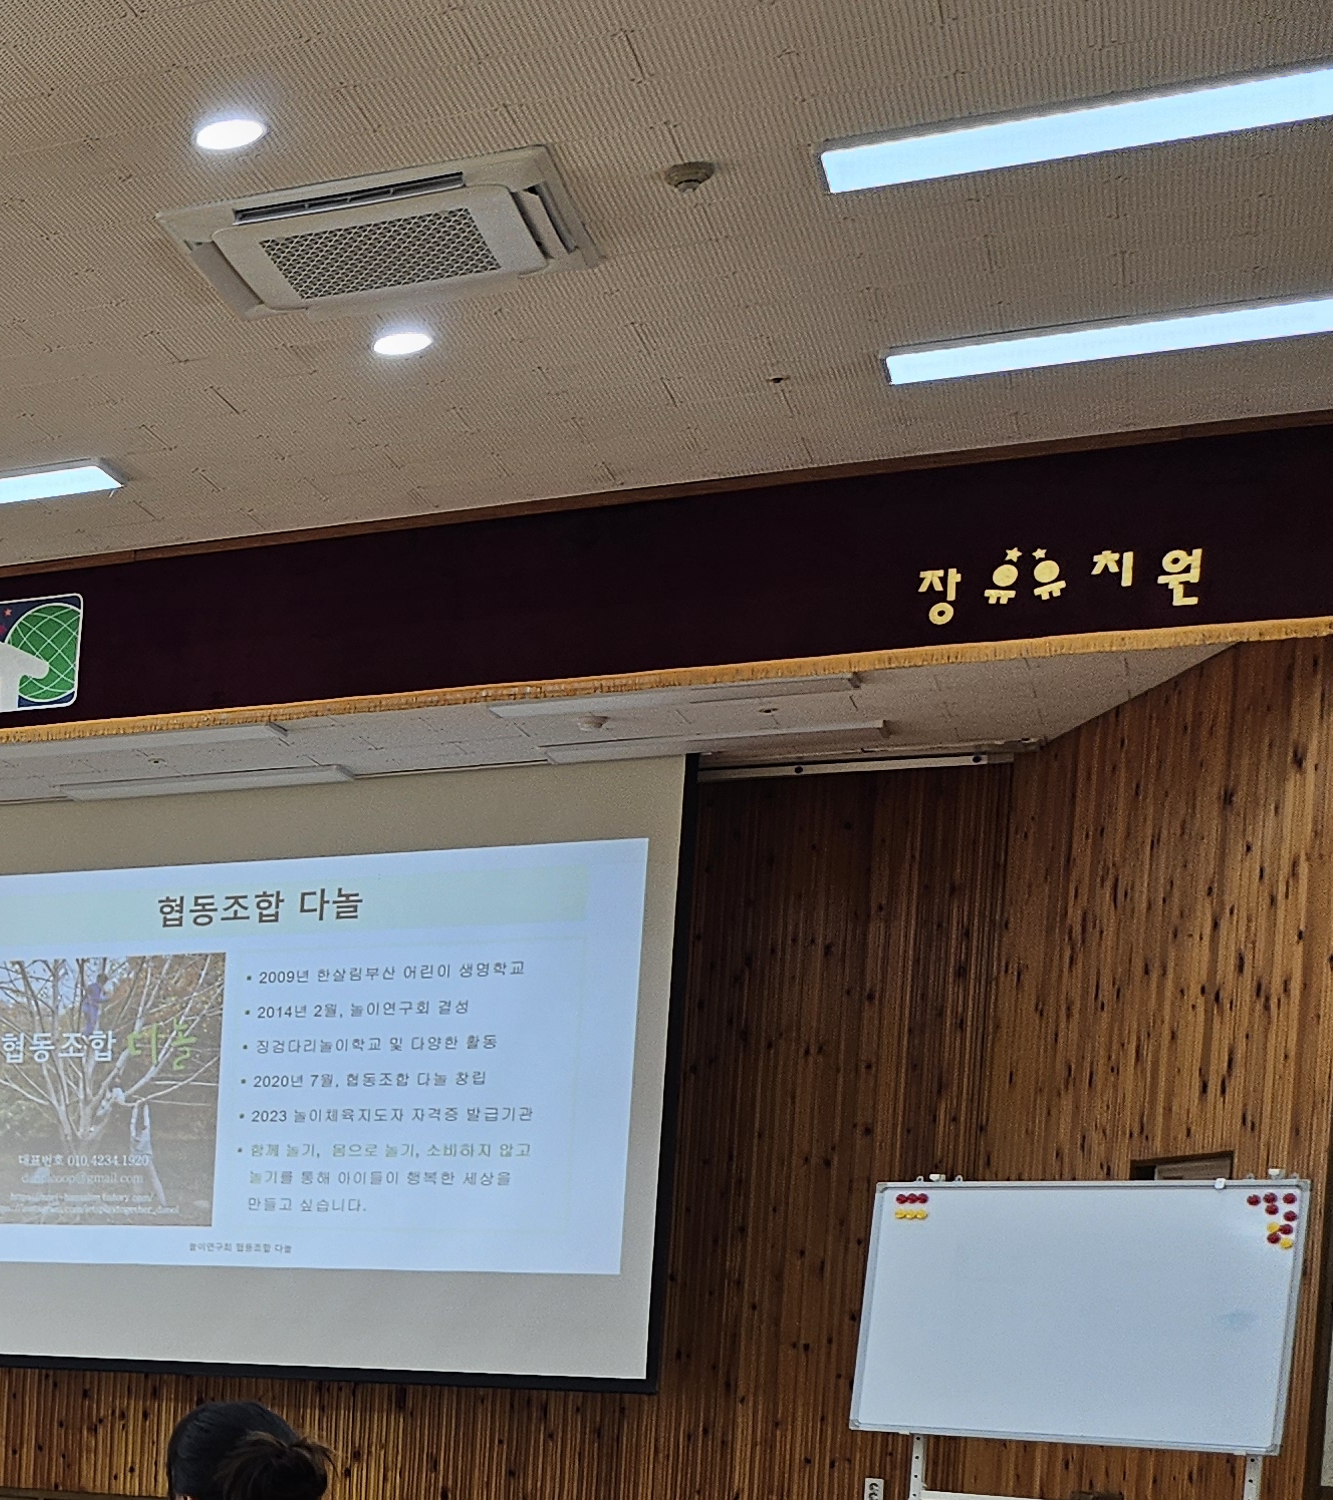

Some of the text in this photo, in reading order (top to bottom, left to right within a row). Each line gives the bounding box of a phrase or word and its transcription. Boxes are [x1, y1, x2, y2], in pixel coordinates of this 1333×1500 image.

[918, 547, 1203, 626] 장유유치원
[158, 887, 363, 928] 협동조합 다놀
[259, 961, 525, 984] 2009년 한살림부산 어린이 생명학교
[257, 1000, 469, 1018] 2014년 2월, 놀이연구회 결성
[1, 1016, 197, 1071] 협동조합 다놀
[257, 1034, 497, 1054] 징검다리놀이학교 및 다양한 활동
[253, 1074, 303, 1088] 2020년
[347, 1072, 409, 1087] 협동조합
[417, 1072, 447, 1087] 다놀
[456, 1071, 486, 1086] 창립
[251, 1107, 533, 1122] 2023 놀이체육지도자 자격증 발급기관
[427, 1143, 491, 1157] 소비하지
[499, 1143, 531, 1157] 않고
[301, 1171, 329, 1185] 통해
[338, 1171, 399, 1185] 아이들이
[407, 1171, 454, 1185] 행복한
[463, 1171, 510, 1186] 세상을
[248, 1198, 292, 1211] 만들고
